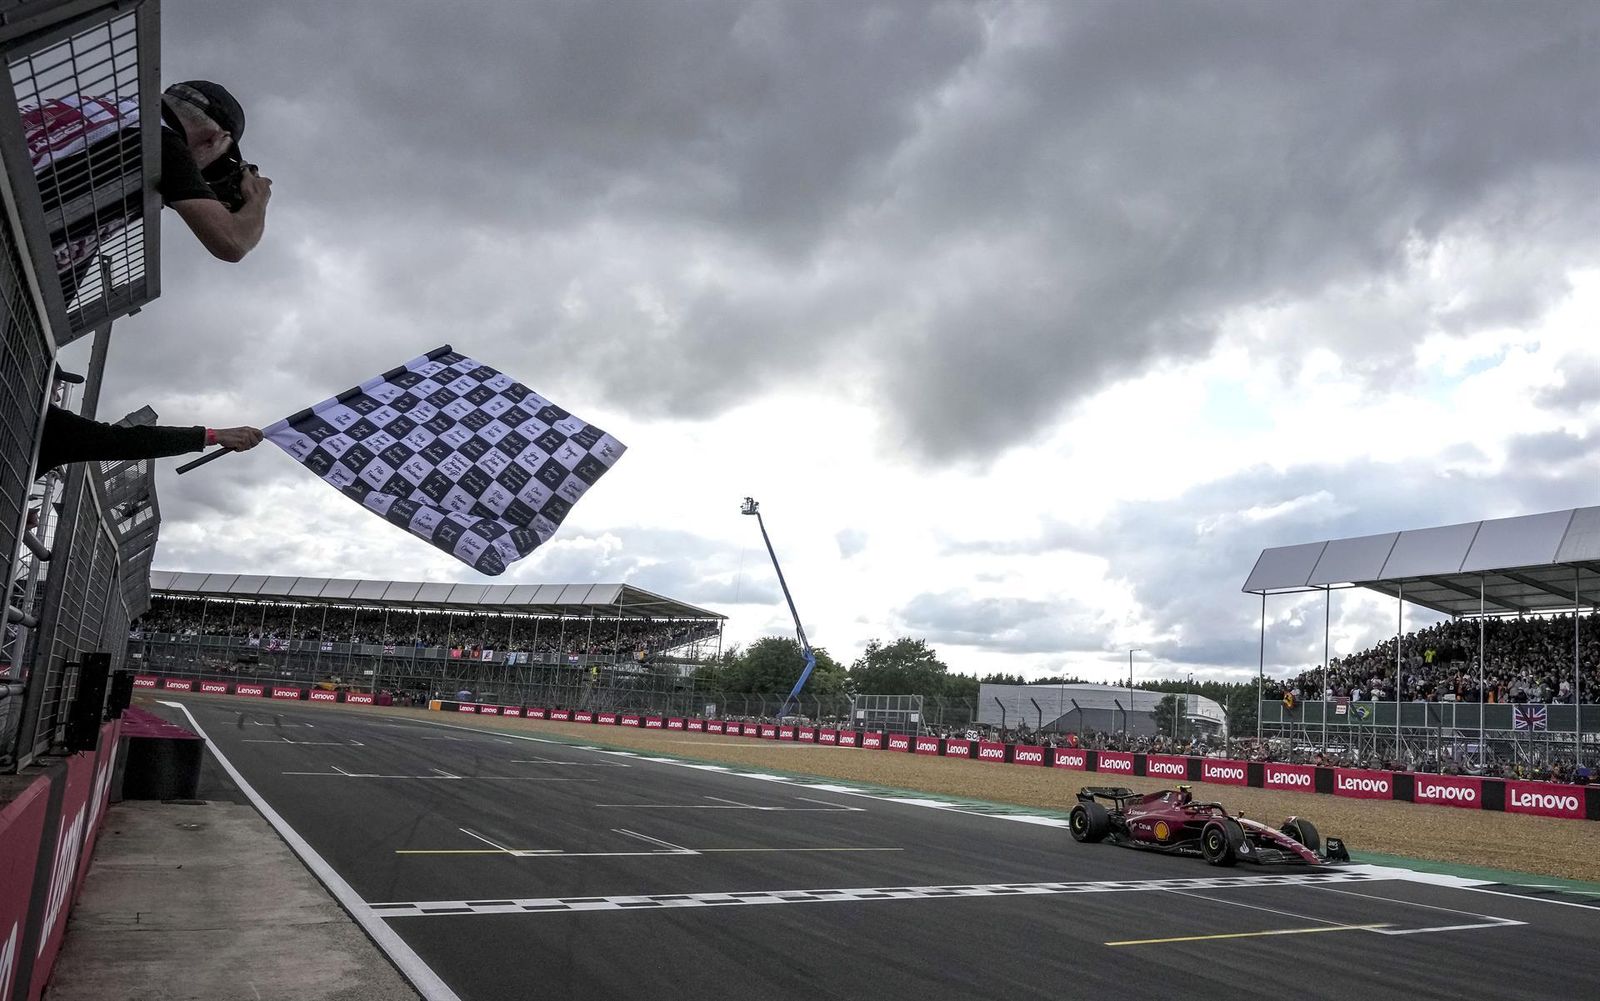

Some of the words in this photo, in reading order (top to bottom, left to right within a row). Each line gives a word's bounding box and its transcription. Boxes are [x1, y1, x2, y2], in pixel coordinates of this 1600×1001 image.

[166, 681, 189, 689] Lenovo
[202, 683, 225, 692] Lenovo
[238, 686, 261, 695] Lenovo
[274, 689, 298, 698] Lenovo
[311, 692, 334, 701] Lenovo
[348, 694, 371, 703] Lenovo
[598, 716, 614, 724] Lenovo
[622, 717, 638, 725] Lenovo
[708, 723, 721, 731] Lenovo
[744, 726, 756, 734] Lenovo
[762, 729, 774, 737] Lenovo
[780, 730, 792, 738] Lenovo
[799, 731, 813, 739] Lenovo
[819, 733, 834, 742] Lenovo
[967, 732, 977, 740] SC
[839, 735, 854, 744] Lenovo
[863, 737, 879, 746] Lenovo
[889, 738, 908, 749] Lenovo
[916, 740, 937, 752] Lenovo
[947, 743, 968, 754] Lenovo
[980, 747, 1003, 758] Lenovo
[1016, 750, 1042, 762] Lenovo
[1056, 753, 1084, 766] Lenovo
[1099, 756, 1131, 771] Lenovo
[1149, 760, 1184, 775] Lenovo
[1204, 763, 1243, 780] Lenovo
[1267, 769, 1311, 786] Lenovo
[1338, 775, 1389, 793] Lenovo
[1418, 781, 1476, 800] Lenovo
[1512, 789, 1579, 811] Lenovo
